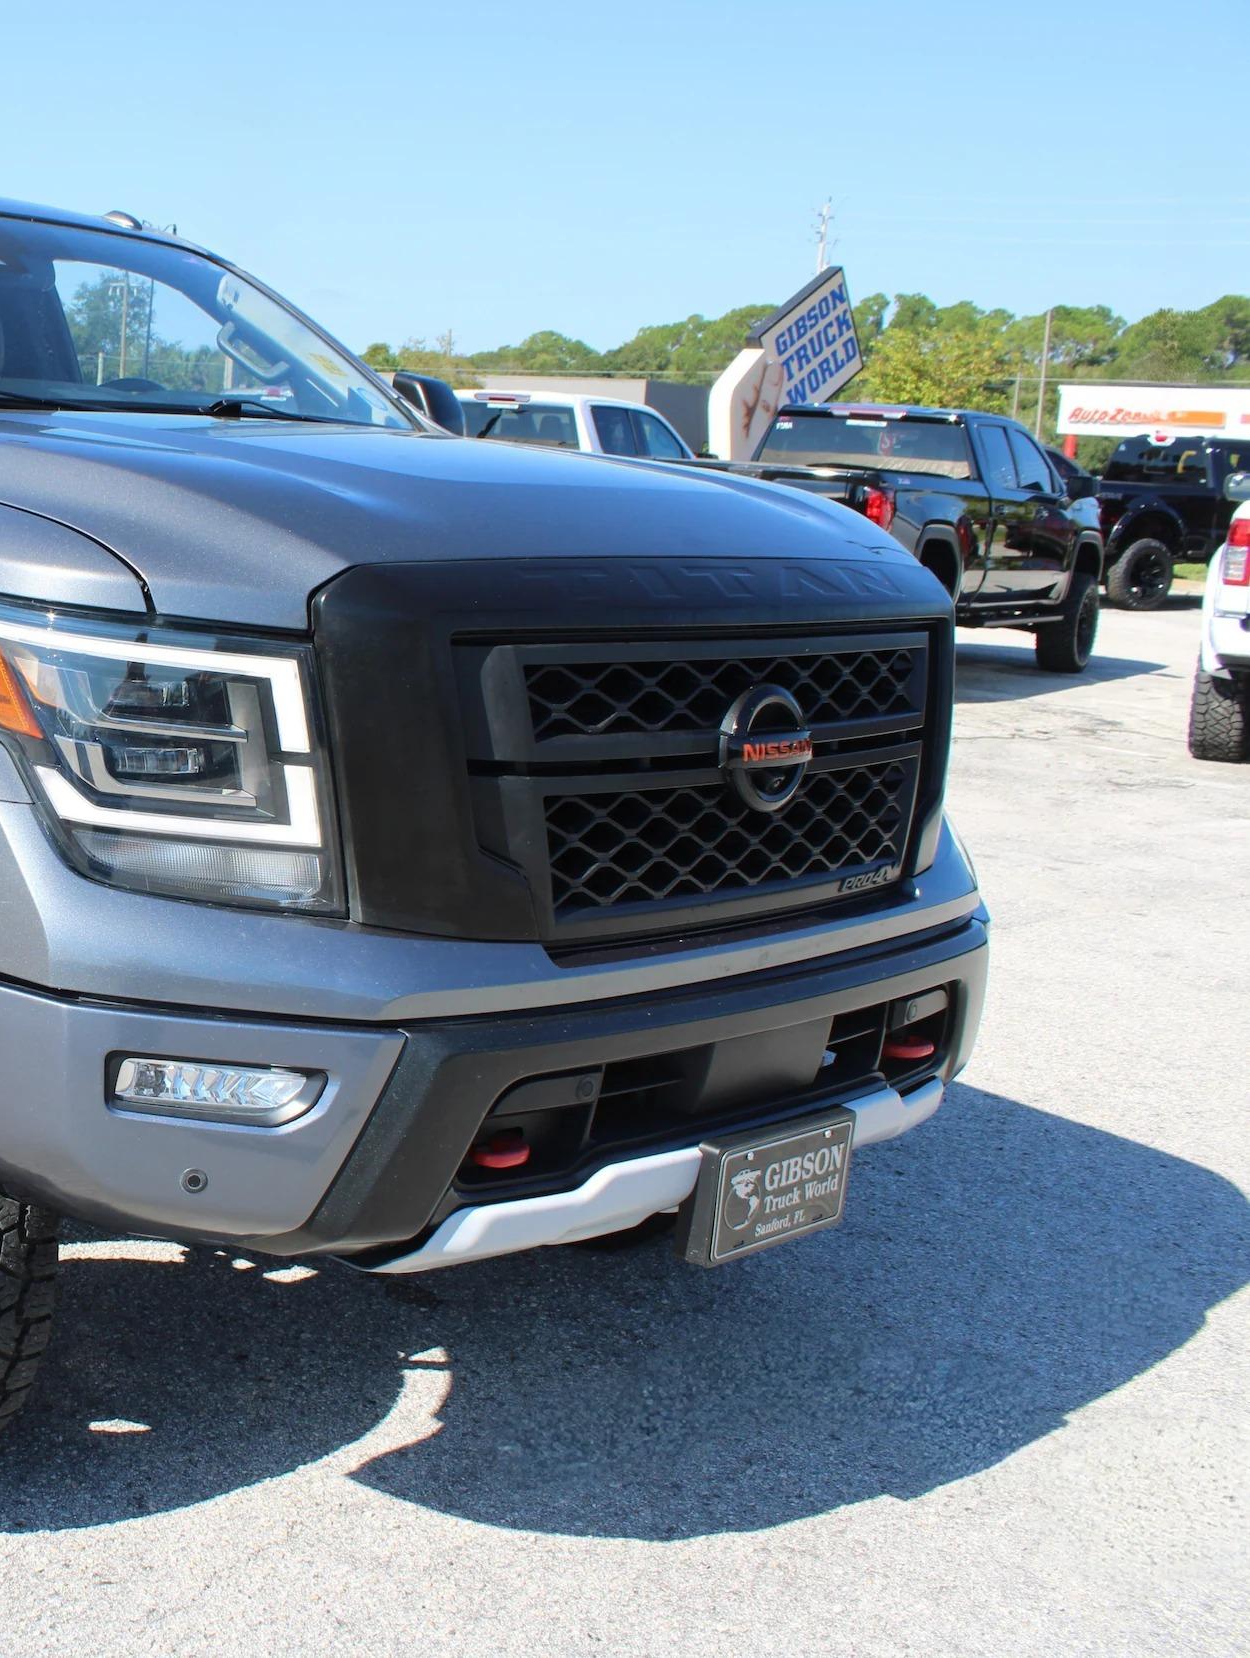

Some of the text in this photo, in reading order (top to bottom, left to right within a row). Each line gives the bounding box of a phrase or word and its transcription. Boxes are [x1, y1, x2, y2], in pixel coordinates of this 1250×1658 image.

[775, 283, 847, 357] GIBSON
[781, 308, 852, 382] TRUCK
[786, 336, 858, 405] WORLD
[516, 565, 907, 599] TITAN
[743, 738, 813, 762] NISSAN
[764, 1142, 846, 1192] GIBSON
[764, 1174, 839, 1214] Truck World
[754, 1209, 806, 1238] Sanford, FL
